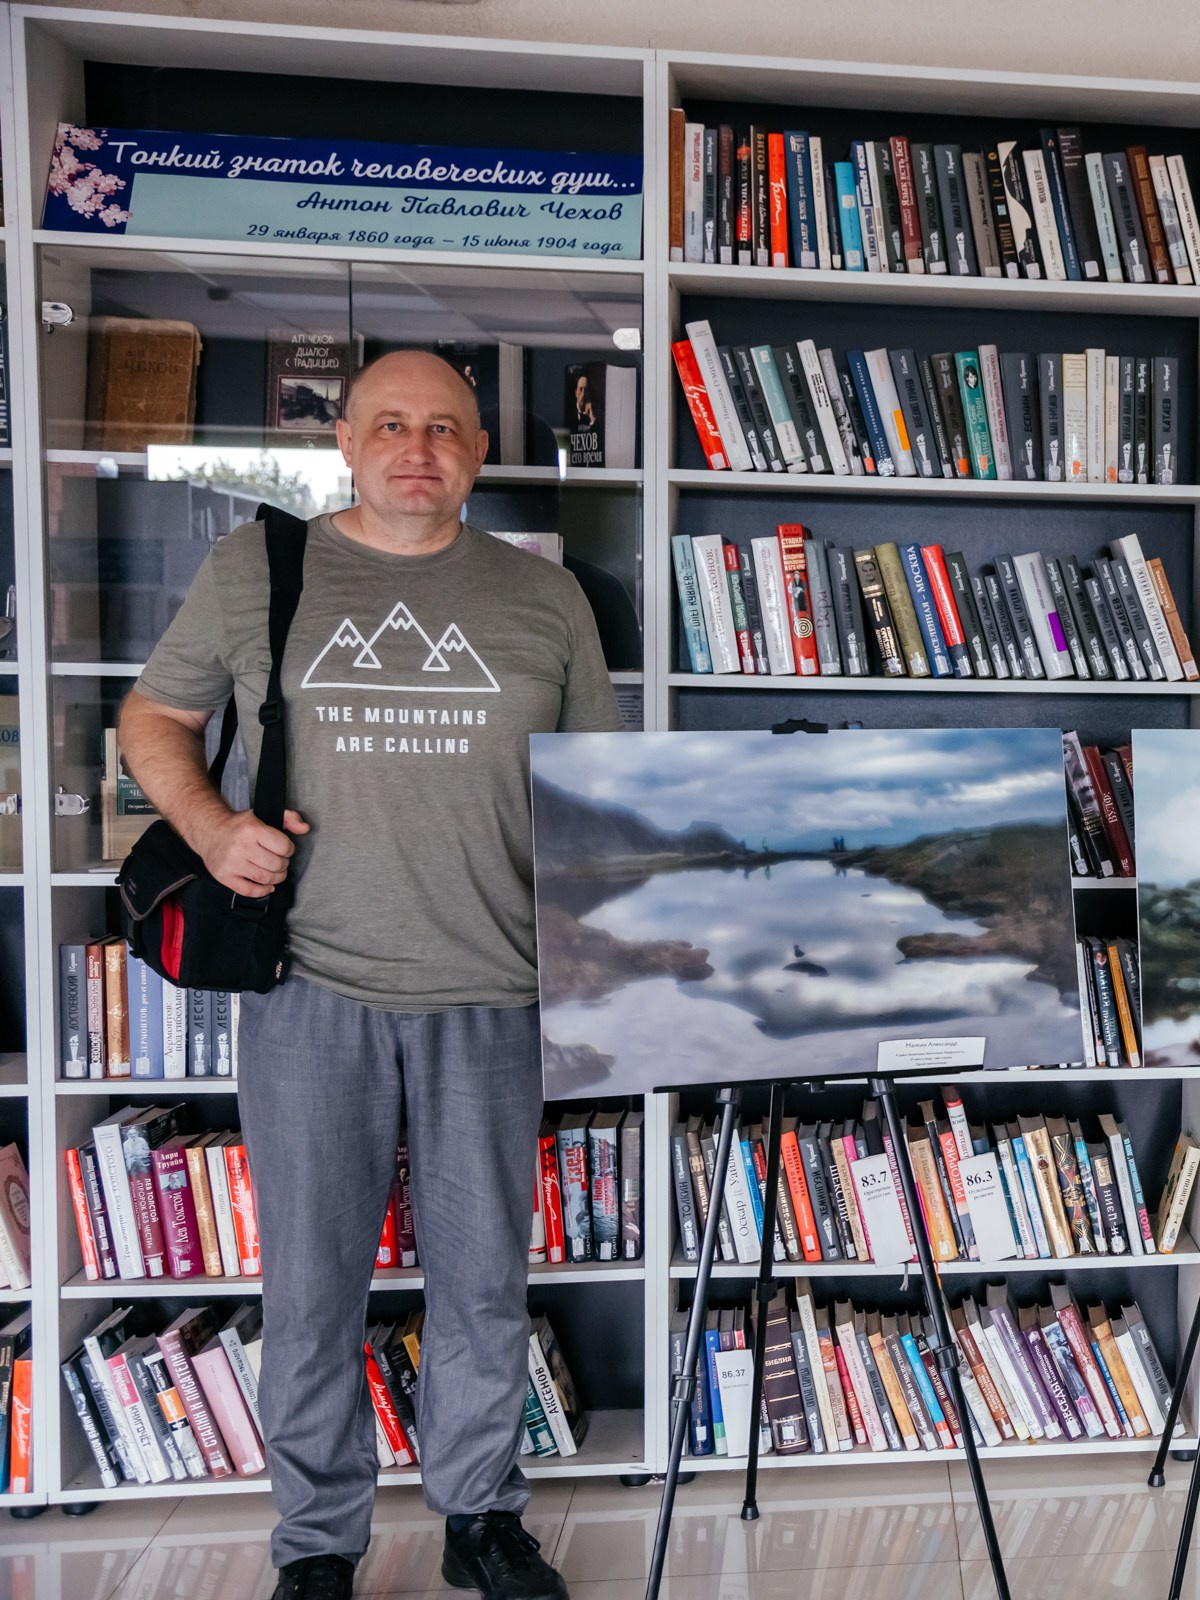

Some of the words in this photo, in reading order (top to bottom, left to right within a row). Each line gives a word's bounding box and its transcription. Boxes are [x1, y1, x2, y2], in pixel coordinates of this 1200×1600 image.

[756, 133, 765, 170] БИТОВ
[108, 142, 224, 171] Тонкий
[227, 153, 346, 179] знаток
[351, 158, 546, 187] человеческих
[549, 170, 636, 194] душ...
[296, 191, 392, 213] Антон
[400, 195, 531, 218] Павлович
[540, 201, 624, 221] Чехов
[739, 183, 749, 242] БЕРБЕРОВА
[247, 224, 269, 237] 29
[272, 228, 343, 244] января
[348, 229, 389, 244] 1860
[394, 234, 436, 247] года
[462, 235, 480, 248] 15
[484, 236, 532, 249] июня
[537, 236, 577, 250] 1904
[583, 241, 624, 256] года
[295, 347, 329, 359] ДИАЛОГ
[308, 335, 334, 345] ЧЕХОВ
[293, 358, 339, 369] ТРАДИЦИЕЙ
[703, 347, 720, 388] ГУМИЛЕВА
[718, 389, 730, 420] Николая
[1021, 395, 1032, 432] ЕСЕНИН
[1161, 398, 1172, 432] КАТАЕВ
[570, 432, 598, 451] ЧЕХОВ
[907, 545, 925, 592] МОСКВА
[731, 574, 744, 604] ЛИМОНОВ
[690, 609, 701, 627] ОЛЕГ
[735, 604, 747, 627] ЭДУАРД
[817, 591, 832, 628] Вера
[980, 596, 992, 621] РЫЖИЙ
[994, 601, 1012, 642] СЕВЕРЯНИН
[1056, 595, 1074, 637] СТАРШИНОВ
[1112, 597, 1130, 635] ФАДЕЕВ
[923, 601, 942, 654] ВСЕЛЕННАЯ
[986, 622, 998, 643] БОРИС
[316, 706, 353, 722] THE
[365, 708, 487, 725] MOUNTAINS
[336, 736, 374, 752] ARE
[385, 737, 470, 754] CALLING
[1104, 792, 1118, 824] ВУЛФ:
[67, 976, 80, 1031] ДОСТОЕВСКИЙ
[1098, 969, 1110, 1008] МАГИЯ
[164, 1003, 175, 1059] Лермонтов:
[173, 1034, 183, 1052] под
[928, 1040, 958, 1048] Александр
[157, 1160, 184, 1170] Труайя
[160, 1152, 181, 1161] Анри
[944, 1138, 966, 1199] РИТОРИКА
[144, 1178, 153, 1189] ЛЕВ
[812, 1171, 829, 1216] ХЕМИНГУЭЙ
[830, 1165, 849, 1222] ШЕКСПИР
[840, 1164, 851, 1191] Гамлета
[861, 1170, 888, 1188] 83.7
[863, 1186, 892, 1197] Ораторское
[966, 1170, 993, 1187] 86.3
[968, 1185, 997, 1196] Отдельные
[1179, 1178, 1191, 1206] РЕЛИГИИ
[1185, 1161, 1196, 1178] МИРА
[146, 1190, 159, 1222] ТОЛСТОЙ
[169, 1192, 185, 1227] Толстой
[678, 1182, 691, 1218] ТОЛКИН
[846, 1192, 857, 1217] Загадка
[973, 1191, 995, 1201] религии
[137, 1180, 147, 1210] «ПРОРОК
[144, 1224, 153, 1249] ЧЕСТИ»
[735, 1200, 750, 1237] Оскар
[1139, 1208, 1153, 1240] КОРА
[175, 1227, 188, 1243] Лев
[171, 1351, 194, 1400] ПИСАТЕЛИ
[721, 1369, 746, 1379] 86.37
[765, 1355, 792, 1367] БИБЛИЯ
[111, 1363, 131, 1401] Прилепин
[534, 1367, 559, 1415] АКСЕНОВ
[803, 1387, 815, 1407] СВЯТЫЕ
[129, 1405, 152, 1447] КНИГОЧЁТ
[847, 1391, 863, 1429] ВАТИКАН
[81, 1415, 96, 1439] АНДРЕЙ
[195, 1410, 218, 1448] СТАЛИН
